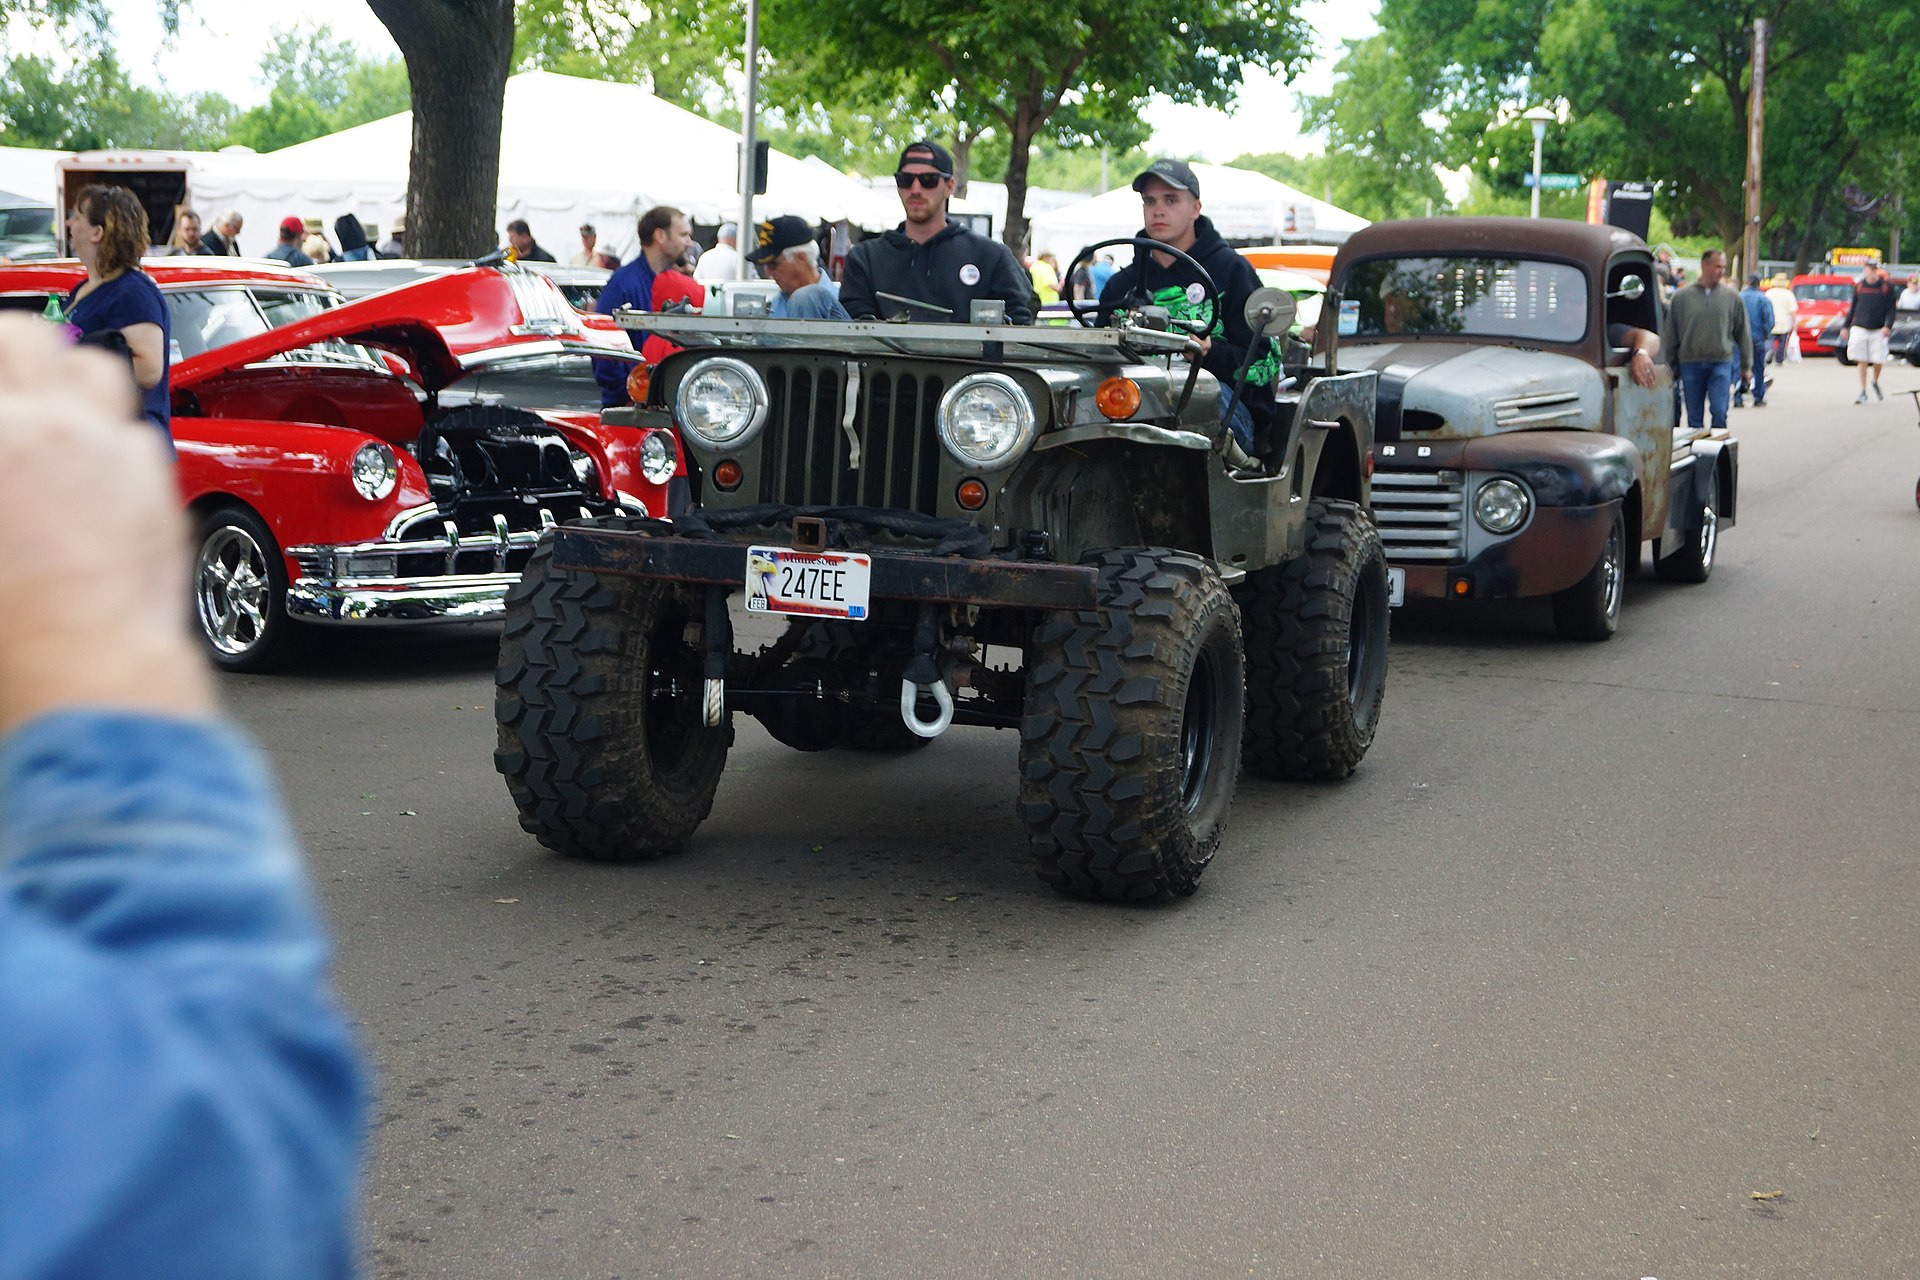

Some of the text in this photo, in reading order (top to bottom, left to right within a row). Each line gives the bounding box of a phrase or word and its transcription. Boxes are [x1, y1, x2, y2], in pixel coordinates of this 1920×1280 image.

[1382, 445, 1432, 457] RD
[783, 552, 838, 567] Minnesota
[781, 567, 846, 602] 247EE
[752, 599, 766, 609] FEB
